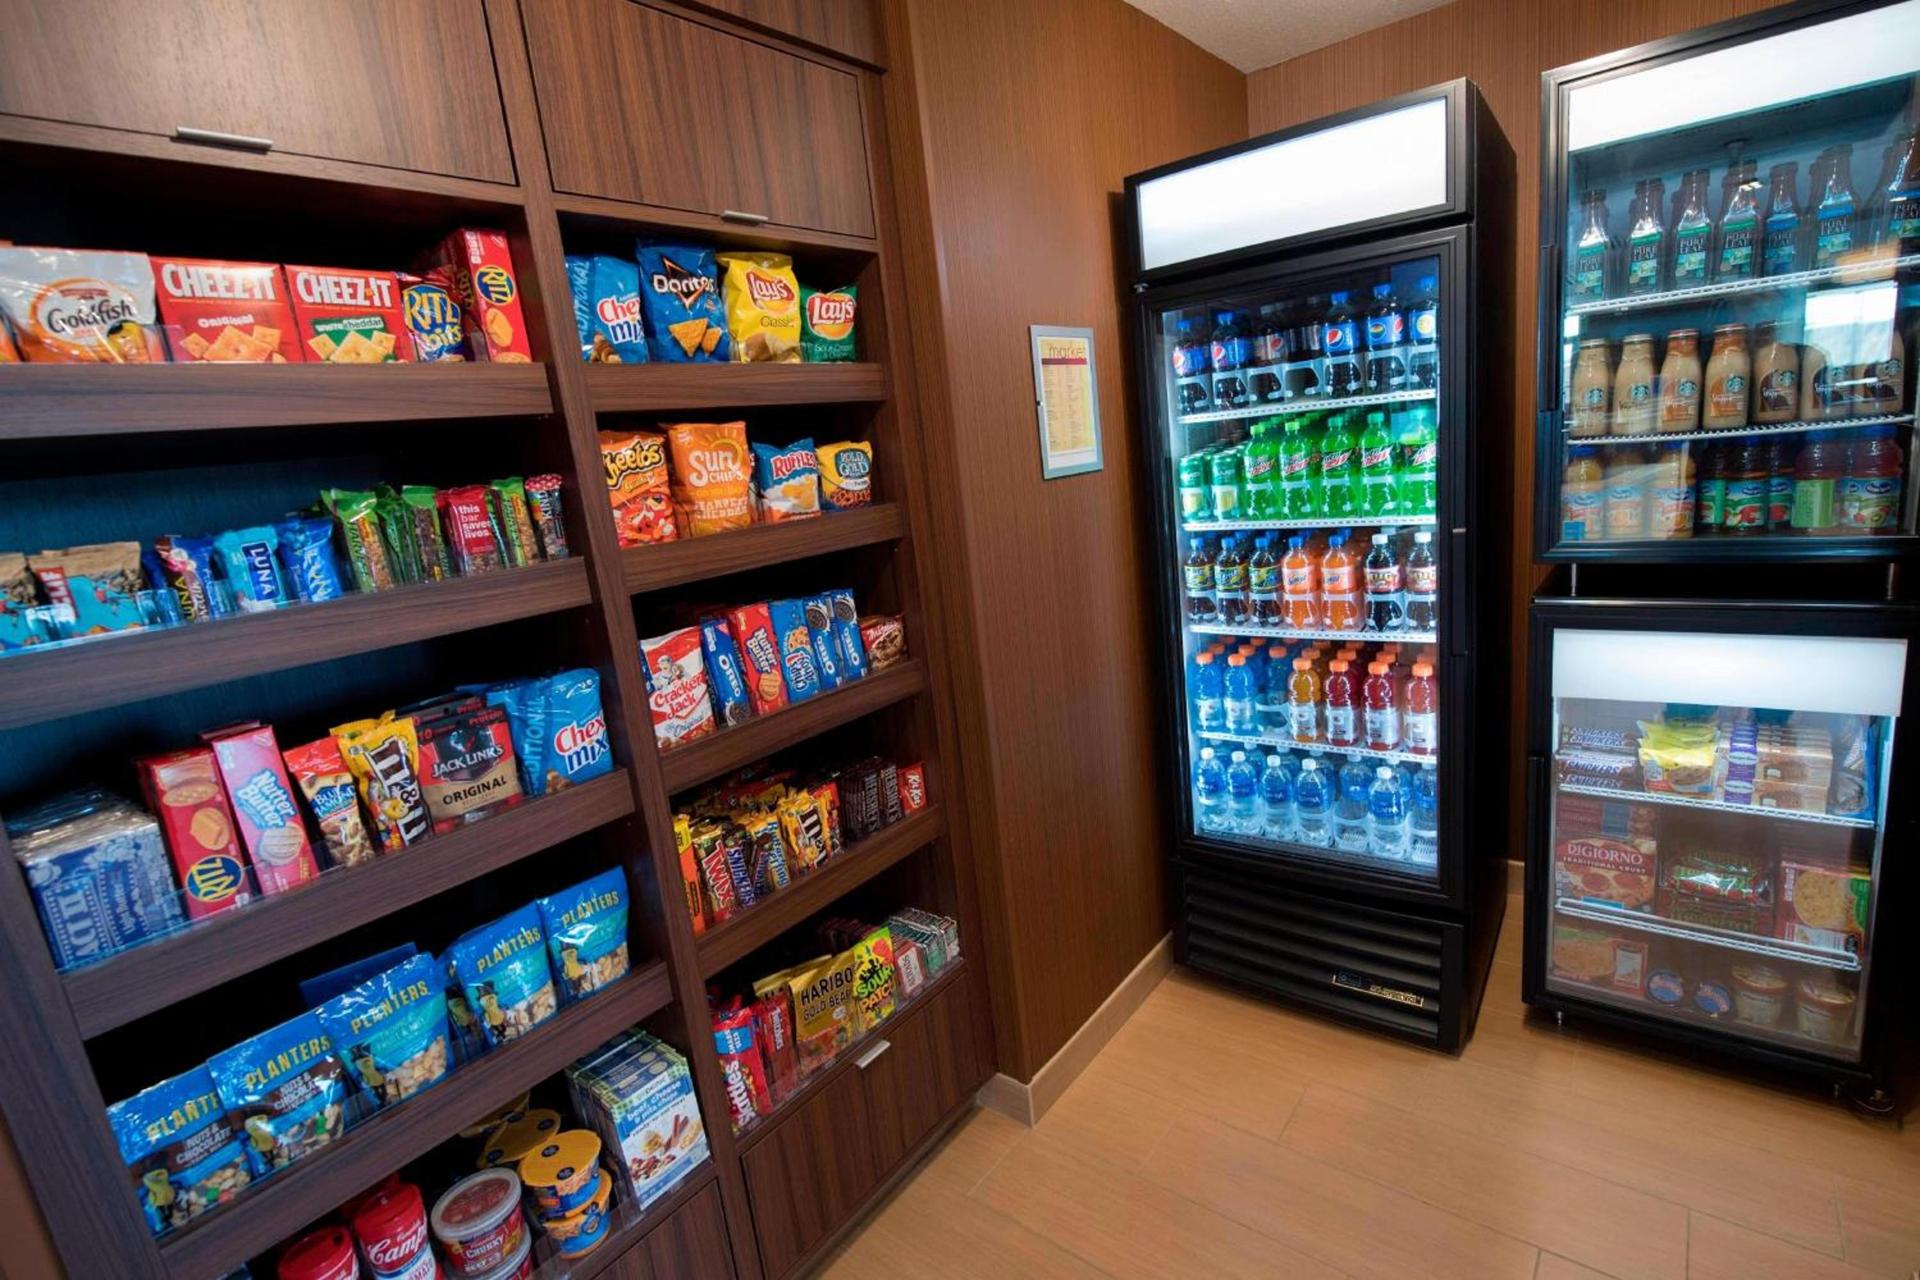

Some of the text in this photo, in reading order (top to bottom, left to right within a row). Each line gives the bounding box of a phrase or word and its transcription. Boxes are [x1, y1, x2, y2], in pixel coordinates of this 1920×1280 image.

[482, 268, 513, 304] RITZ
[652, 273, 719, 294] Doritos
[749, 271, 790, 300] Lay's
[48, 299, 134, 333] Goldfish
[403, 288, 461, 332] RITZ
[812, 296, 855, 325] Lay's
[689, 449, 734, 488] Sun
[708, 465, 744, 483] CHIPS
[771, 449, 817, 480] RUFFLES
[840, 461, 869, 476] GOLD
[458, 504, 481, 515] this
[461, 513, 480, 523] bar
[538, 491, 551, 520] KIND
[462, 521, 491, 531] saves
[250, 547, 273, 596] LUNA
[745, 639, 772, 674] Butter
[753, 628, 778, 666] Nutter
[815, 635, 836, 674] OREO
[844, 627, 860, 667] OREO
[653, 674, 704, 709] Cracker
[718, 654, 742, 698] OREO
[666, 695, 700, 720] Jack
[554, 718, 607, 757] Chex
[431, 744, 505, 778] JACK LINK'S
[565, 738, 610, 774] mix
[1567, 760, 1620, 775] SNICKERS
[236, 784, 287, 829] Butter
[257, 769, 297, 817] Nutter
[442, 775, 508, 806] ORIGINAL
[864, 773, 881, 832] HERSHEY'S
[883, 765, 903, 823] HERSHEY'S
[1562, 856, 1617, 871] TRADITIONAL
[1567, 843, 1644, 866] DIGIORNO
[190, 857, 236, 901] RITZ
[703, 840, 736, 907] TWIX
[727, 848, 756, 906] SNICKERS
[562, 890, 620, 929] PLANTERS
[476, 927, 542, 973] PLANTERS
[800, 966, 854, 1006] HARIBO
[855, 964, 894, 999] SOUR
[858, 980, 895, 1013] PATCH
[351, 980, 430, 1035] PLANTERS
[802, 1002, 829, 1022] GOLD
[770, 1006, 785, 1051] Twizzlers
[244, 1035, 333, 1091] PLANTERS
[279, 1076, 303, 1095] NUTS
[650, 1080, 683, 1105] cheese
[726, 1059, 757, 1128] Skittles
[184, 1129, 210, 1149] NUTS
